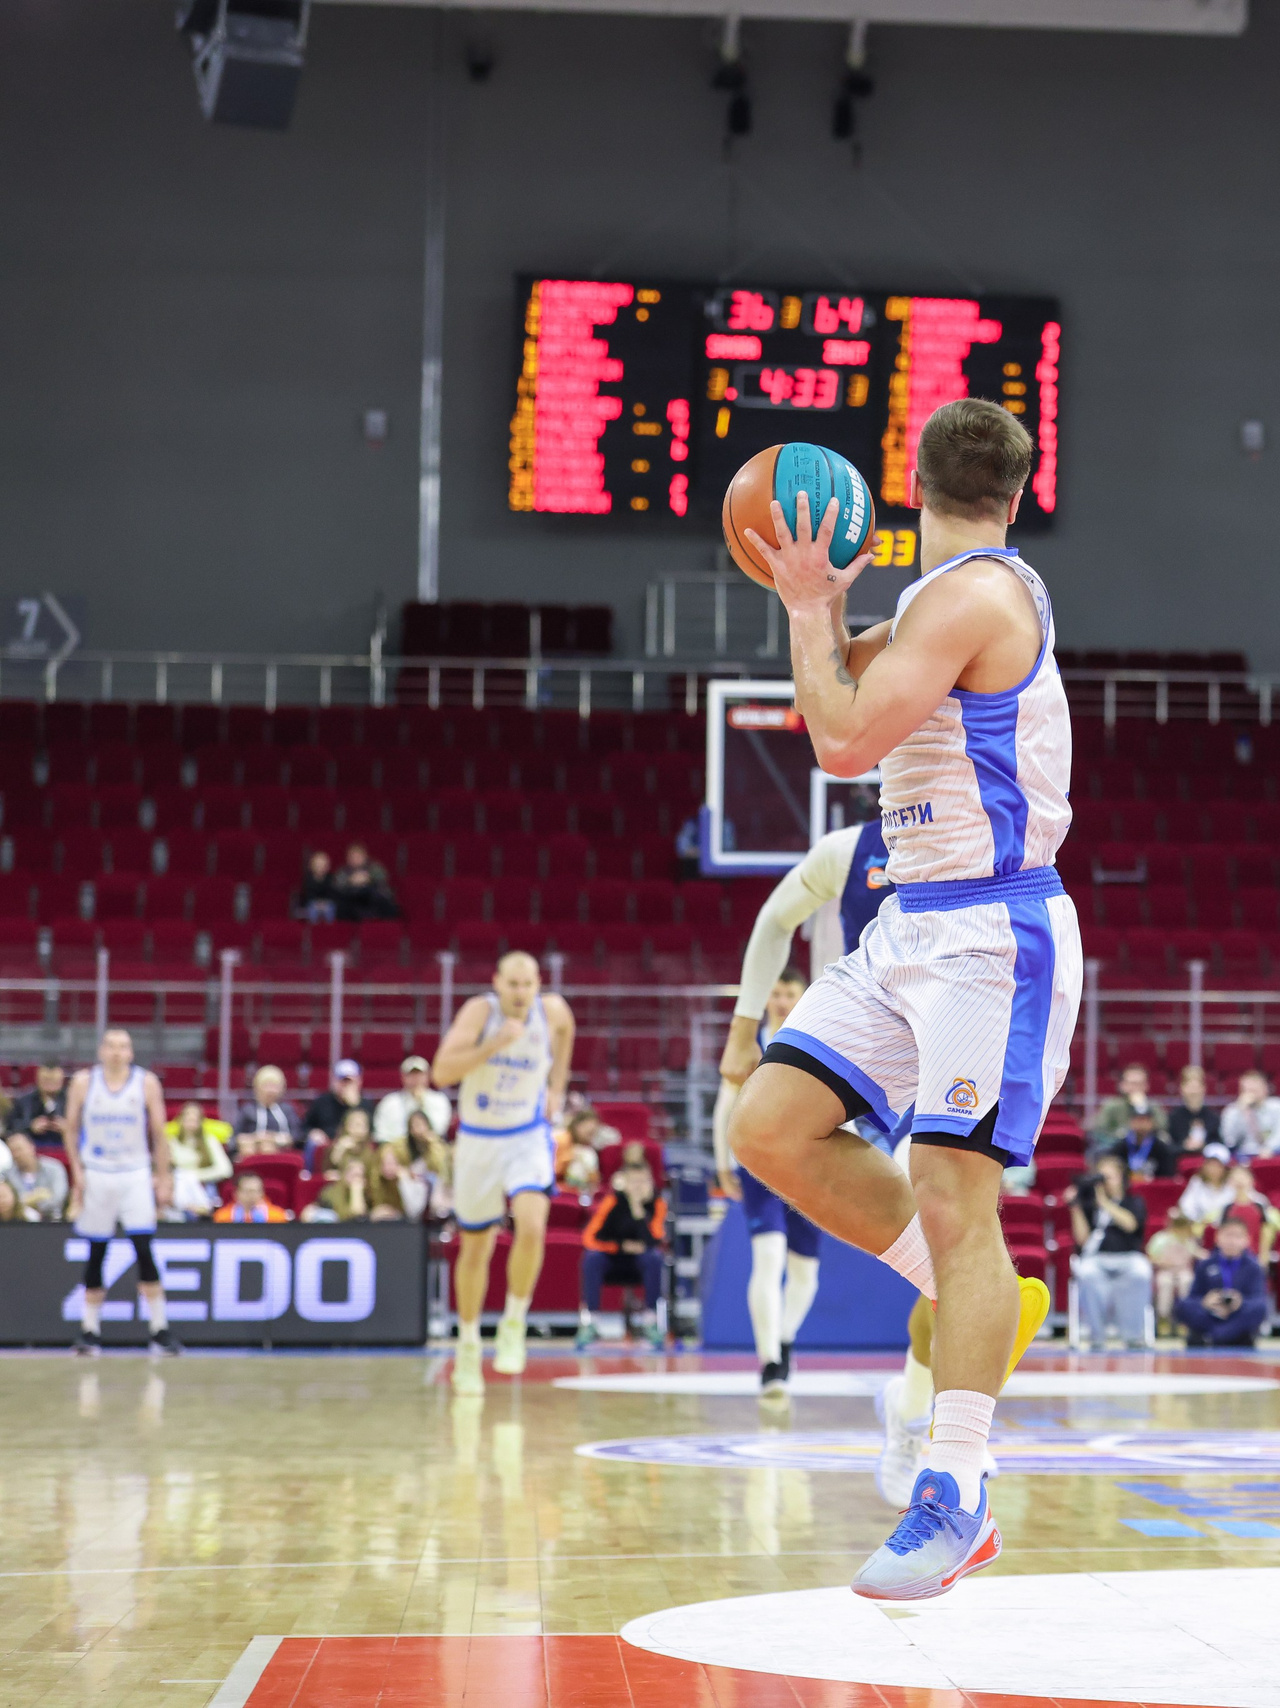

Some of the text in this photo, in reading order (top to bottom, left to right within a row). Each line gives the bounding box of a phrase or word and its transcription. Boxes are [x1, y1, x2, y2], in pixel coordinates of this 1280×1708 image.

[727, 290, 775, 331] 36
[813, 295, 864, 334] 64
[759, 367, 839, 409] 4:33
[814, 491, 821, 500] OF
[845, 464, 865, 544] SIBUR
[18, 599, 40, 641] 7
[947, 1106, 973, 1116] САМАРА
[62, 1237, 377, 1323] ZEDO
